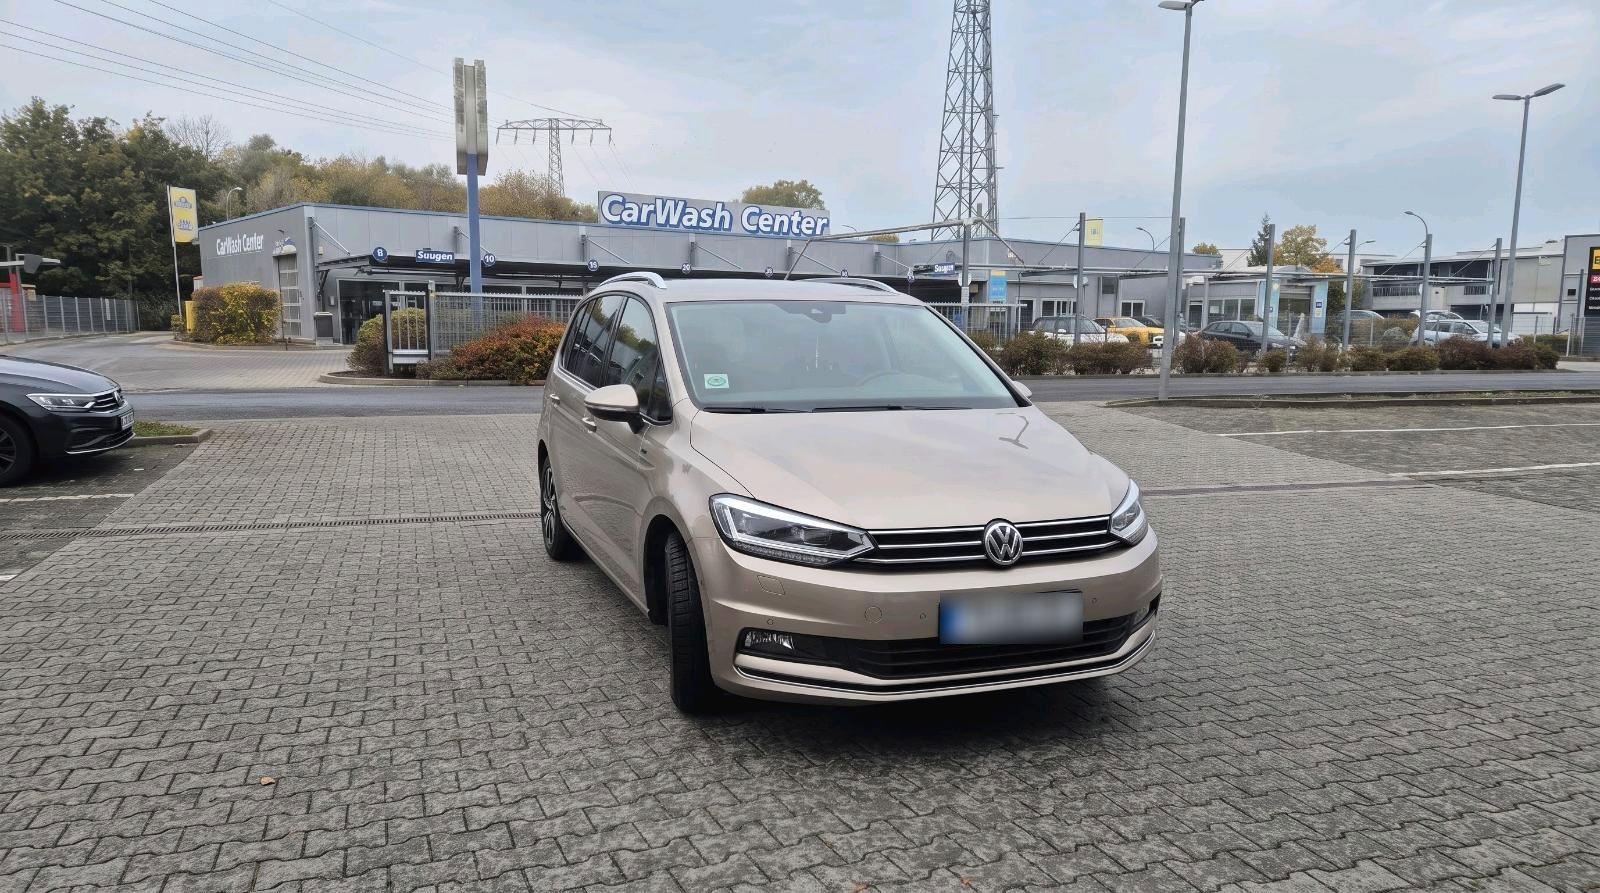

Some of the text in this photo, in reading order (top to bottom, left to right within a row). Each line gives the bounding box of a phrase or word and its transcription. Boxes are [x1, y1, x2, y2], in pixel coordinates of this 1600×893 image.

[601, 194, 829, 237] CarWash Center
[216, 234, 242, 256] CarWash
[243, 232, 264, 252] Center
[484, 254, 495, 263] 10
[985, 522, 1022, 564] VW
